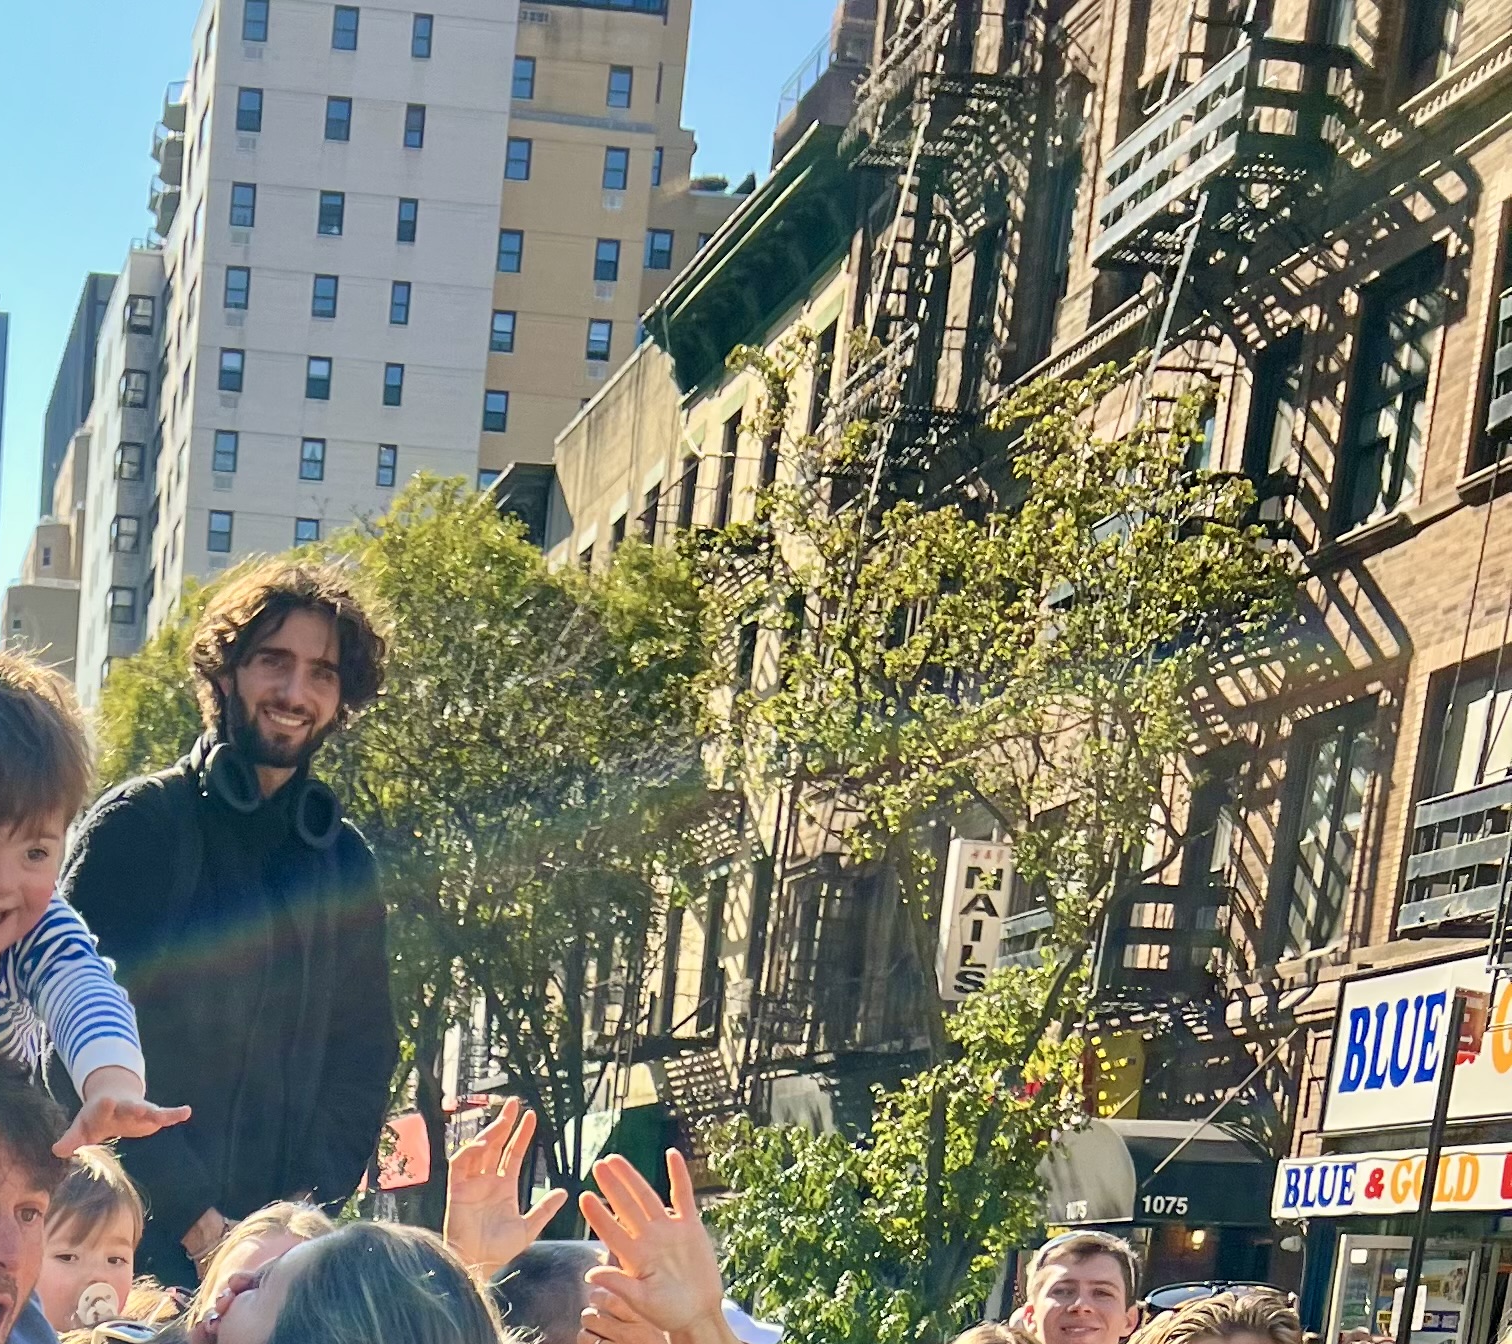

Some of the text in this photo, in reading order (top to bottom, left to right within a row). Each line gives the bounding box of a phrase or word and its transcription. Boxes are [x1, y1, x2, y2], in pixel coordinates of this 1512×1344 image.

[954, 866, 1003, 994] NAILS
[1339, 989, 1446, 1094] BLUE
[1142, 1195, 1188, 1215] 1075
[1282, 1162, 1357, 1208] BLUE
[1364, 1167, 1384, 1200] &
